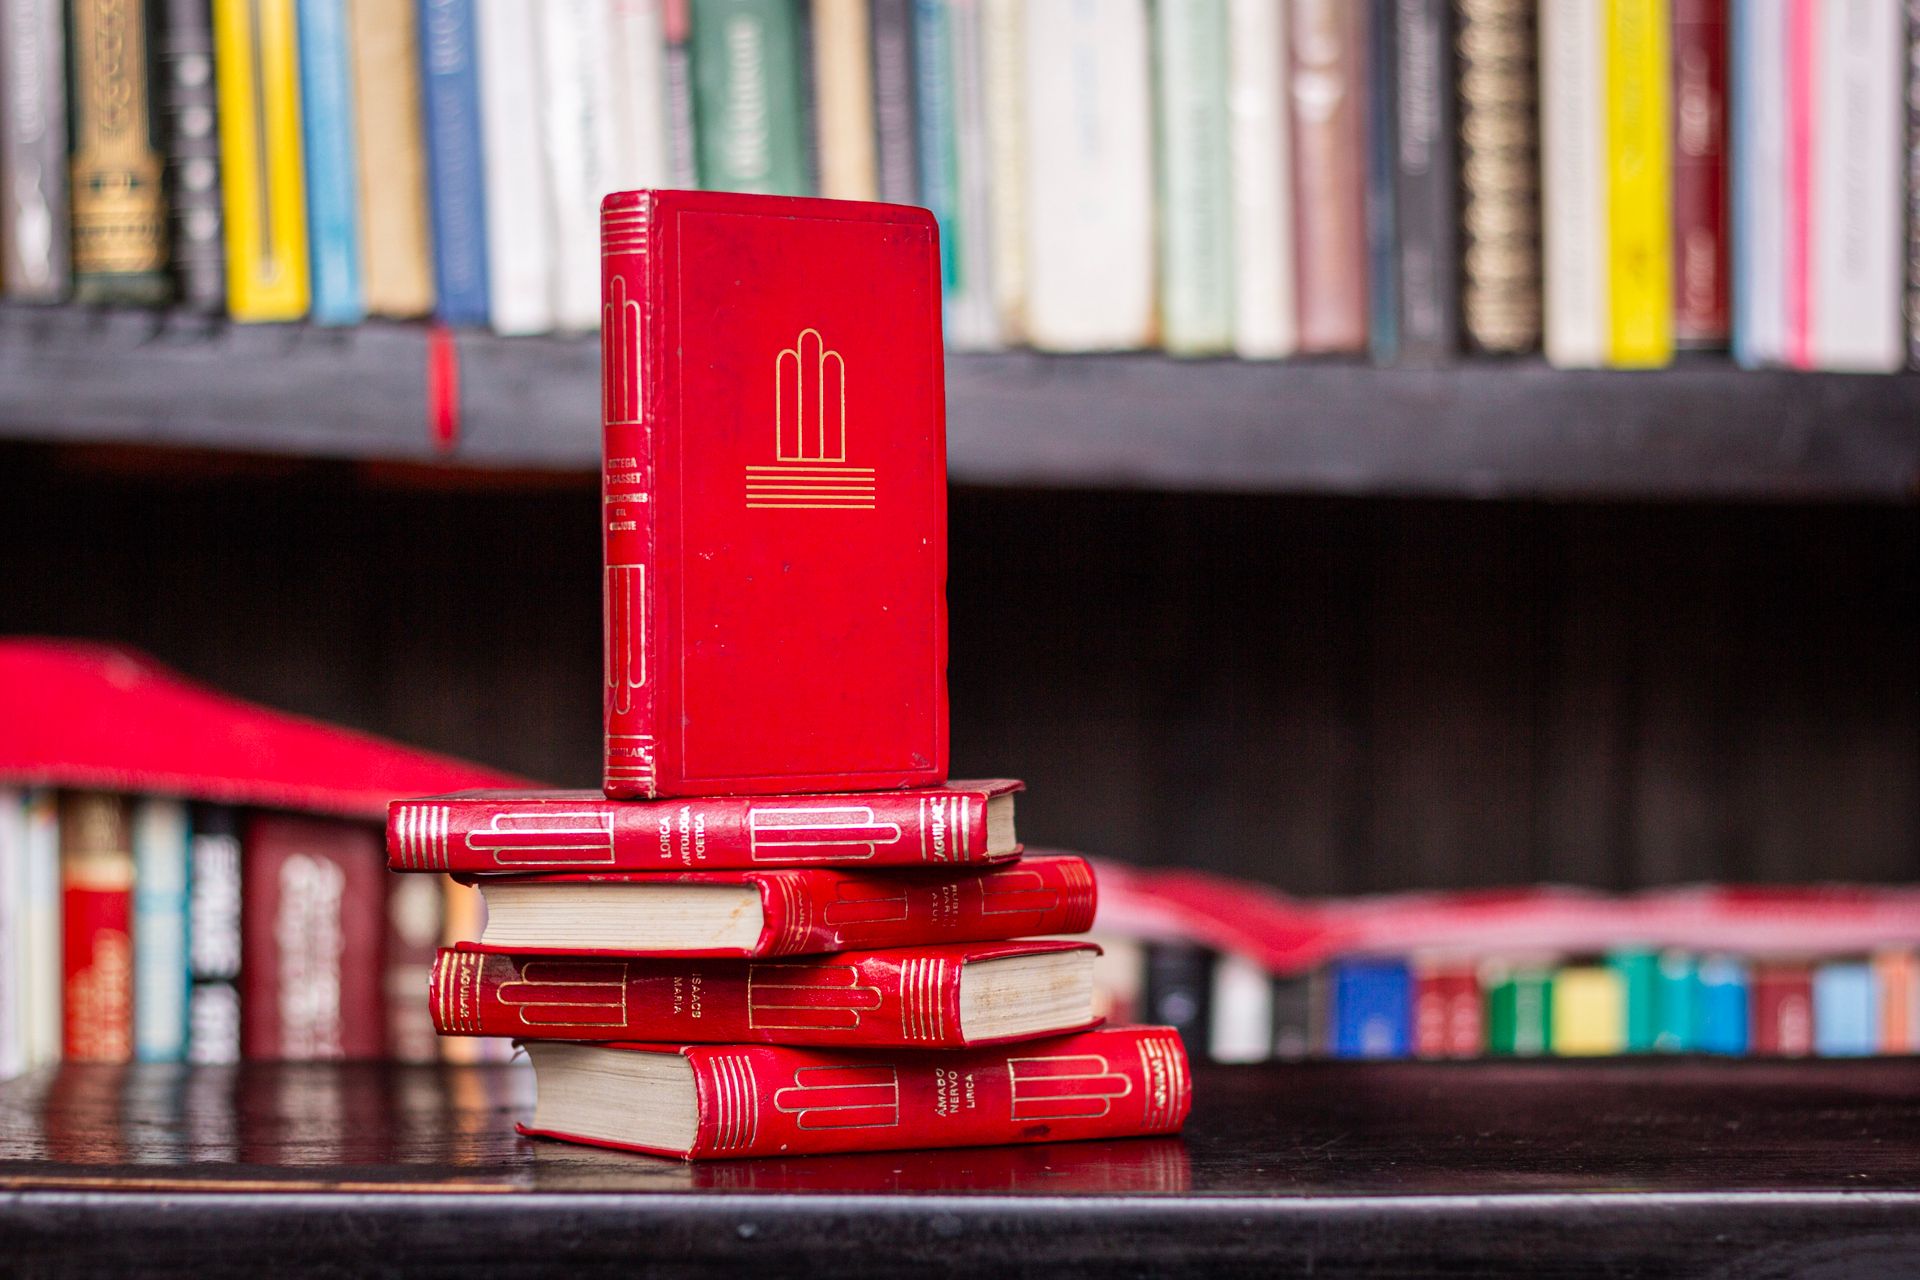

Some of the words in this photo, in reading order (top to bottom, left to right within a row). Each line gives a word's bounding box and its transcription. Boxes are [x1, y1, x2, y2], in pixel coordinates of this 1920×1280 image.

[659, 815, 672, 859] LORCA
[460, 965, 471, 1018] AGUILAR
[935, 1068, 947, 1117] AMADO
[948, 1071, 960, 1114] NERVO
